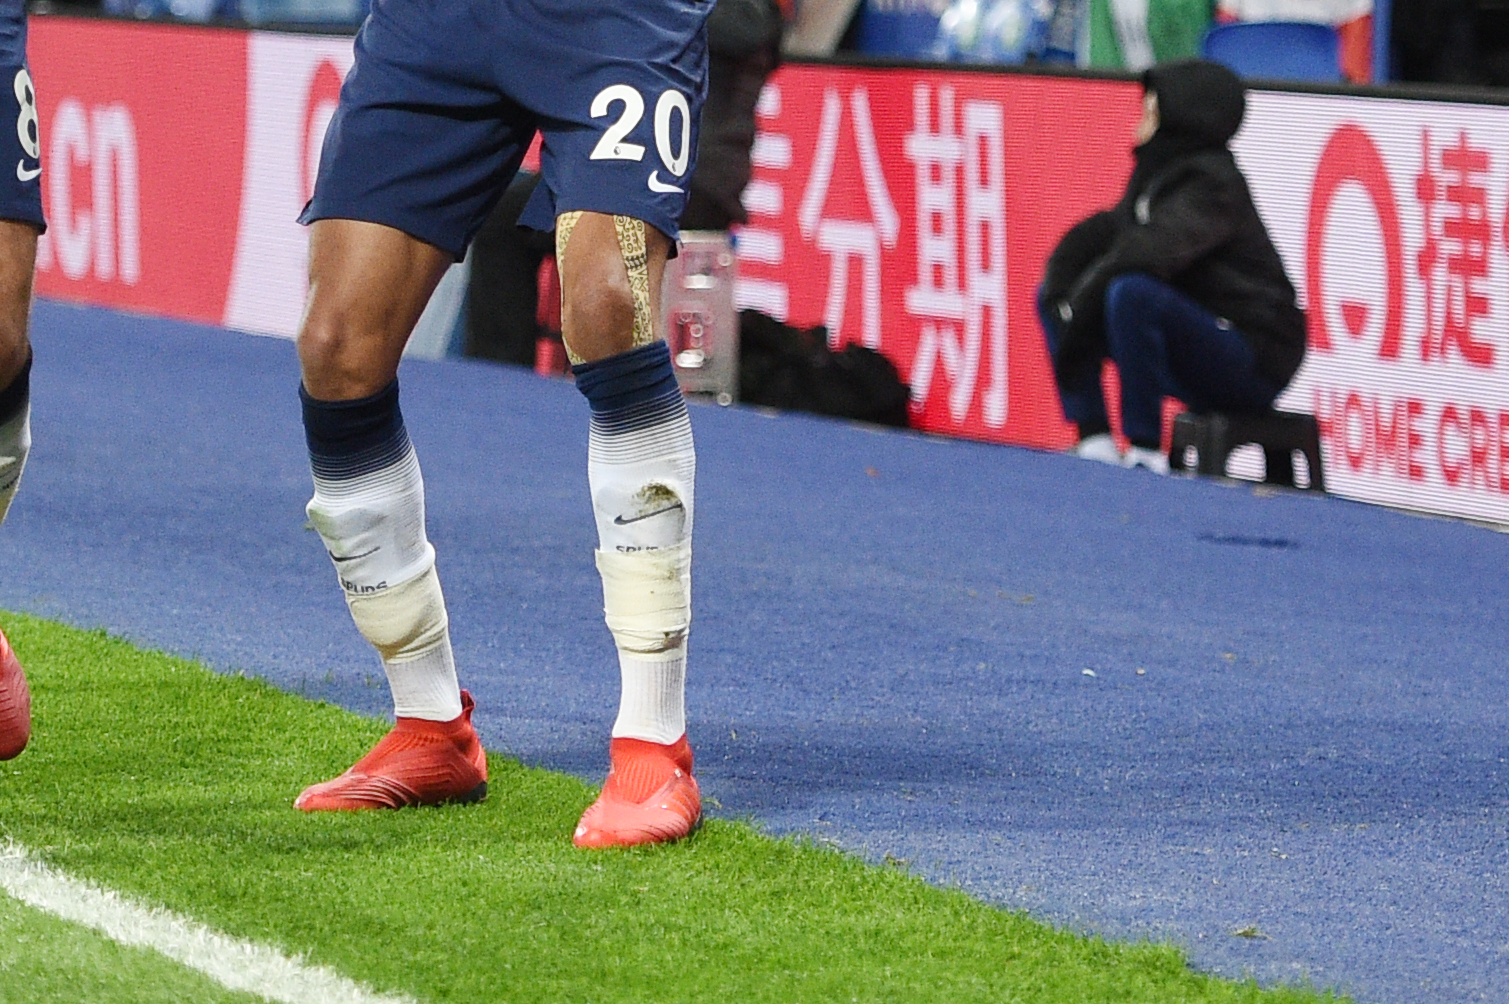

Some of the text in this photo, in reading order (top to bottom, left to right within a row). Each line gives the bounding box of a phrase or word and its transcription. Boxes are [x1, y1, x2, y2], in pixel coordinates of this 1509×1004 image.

[13, 68, 40, 159] 8
[589, 84, 691, 177] 20
[1415, 123, 1509, 371] 捷
[1314, 388, 1425, 485] HOME
